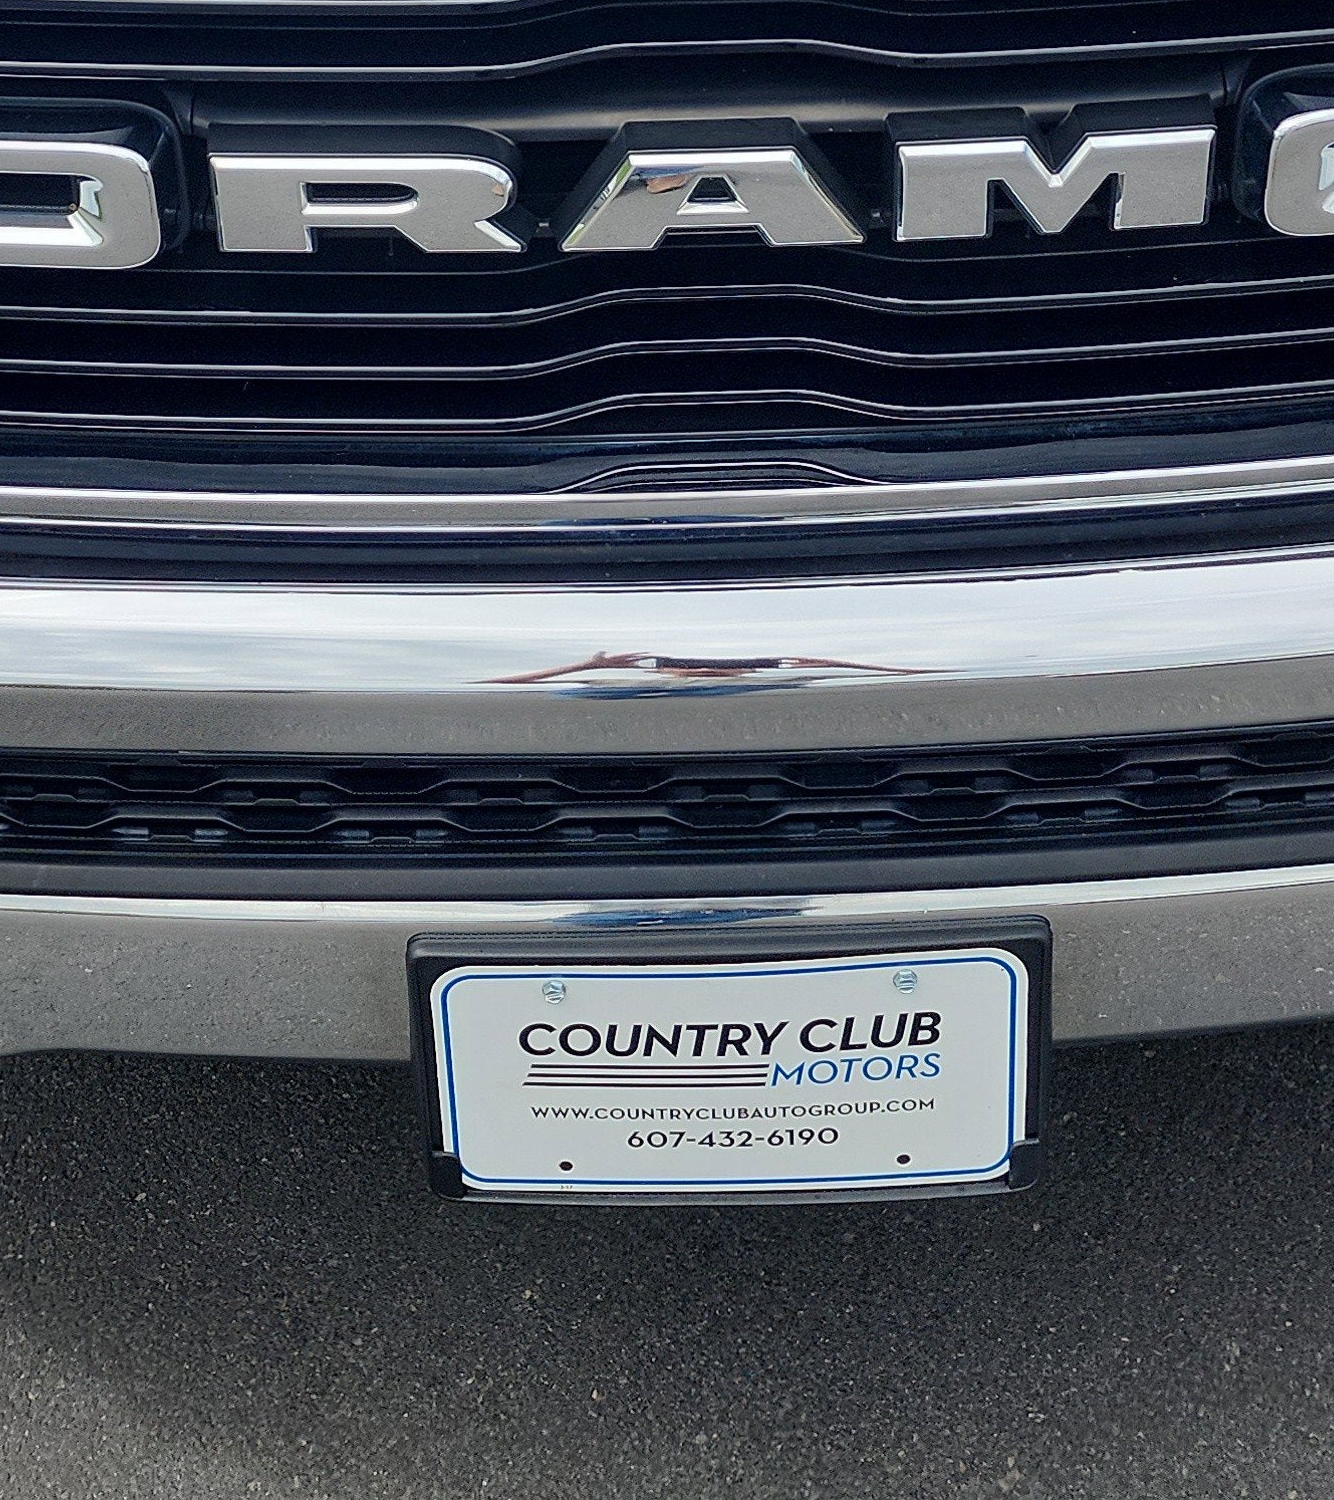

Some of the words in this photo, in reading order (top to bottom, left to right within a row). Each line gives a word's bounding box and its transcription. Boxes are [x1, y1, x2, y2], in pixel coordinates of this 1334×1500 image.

[208, 123, 1217, 254] RAM
[518, 1020, 790, 1058] COUNTRY
[799, 1011, 943, 1053] CLUB
[771, 1052, 942, 1087] MOTORS
[530, 1098, 935, 1120] WWW.COUNTRYCLUBAUTOGROUP.COM
[627, 1127, 839, 1148] 607-432-6190
